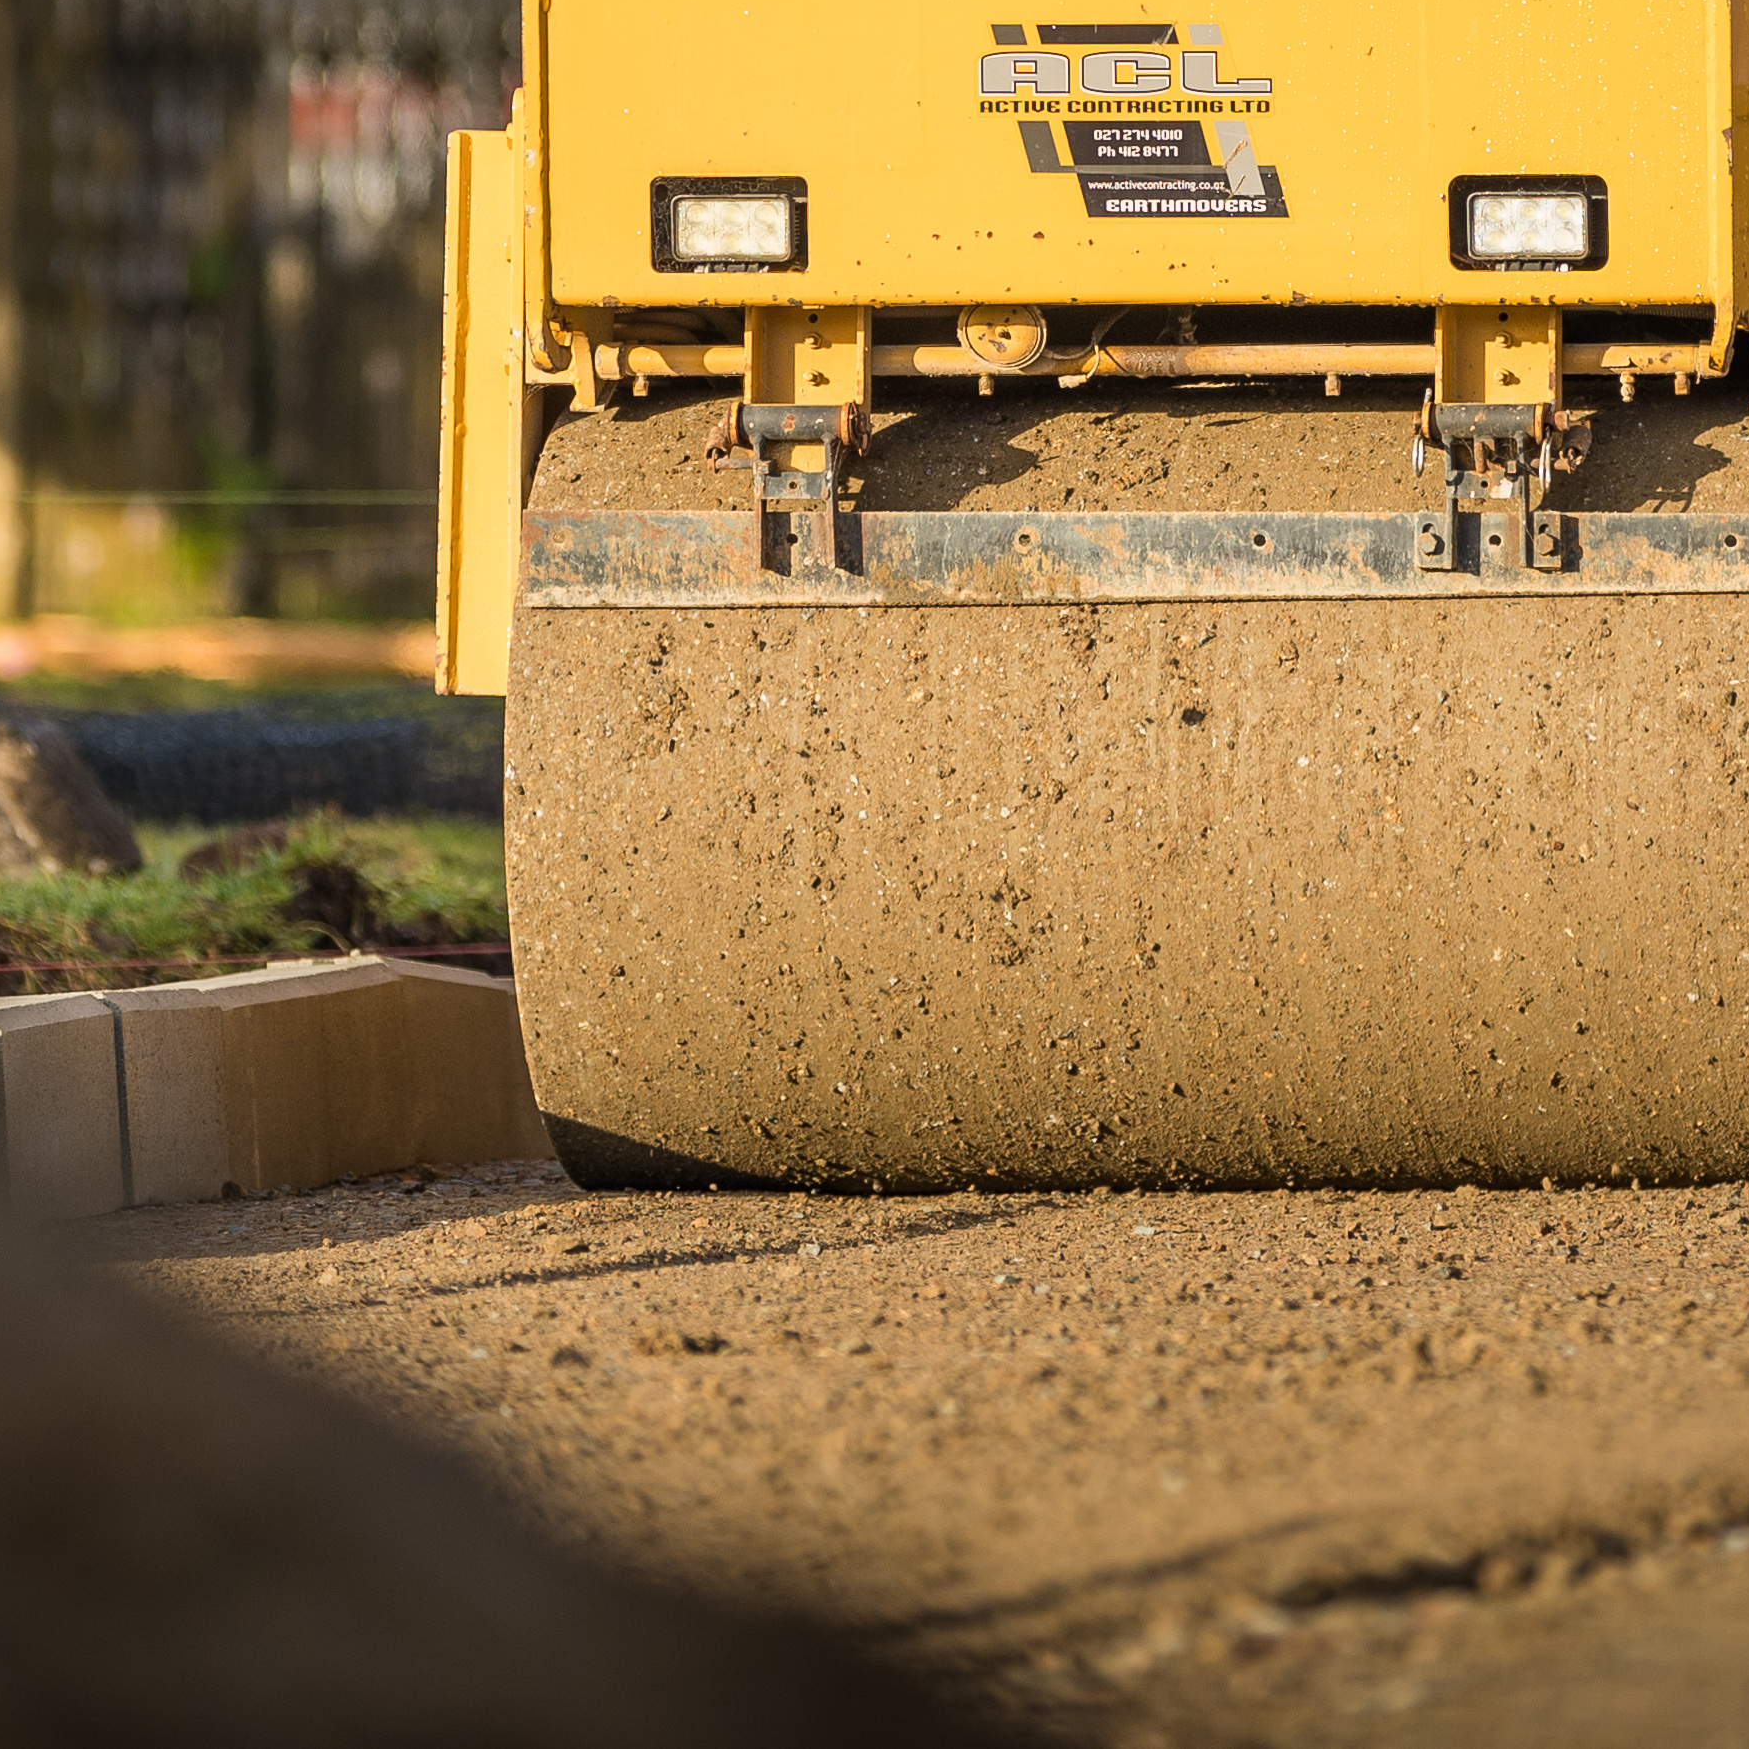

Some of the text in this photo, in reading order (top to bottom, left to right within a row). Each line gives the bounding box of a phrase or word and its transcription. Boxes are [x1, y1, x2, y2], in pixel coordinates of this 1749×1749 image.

[979, 51, 1272, 97] ACL
[980, 100, 1270, 114] ACTIVE CONTRACTING LTD
[1093, 129, 1183, 141] 027 274 4010
[1097, 145, 1179, 158] Ph 412 8477
[1105, 199, 1267, 213] EARTHMOVERS
